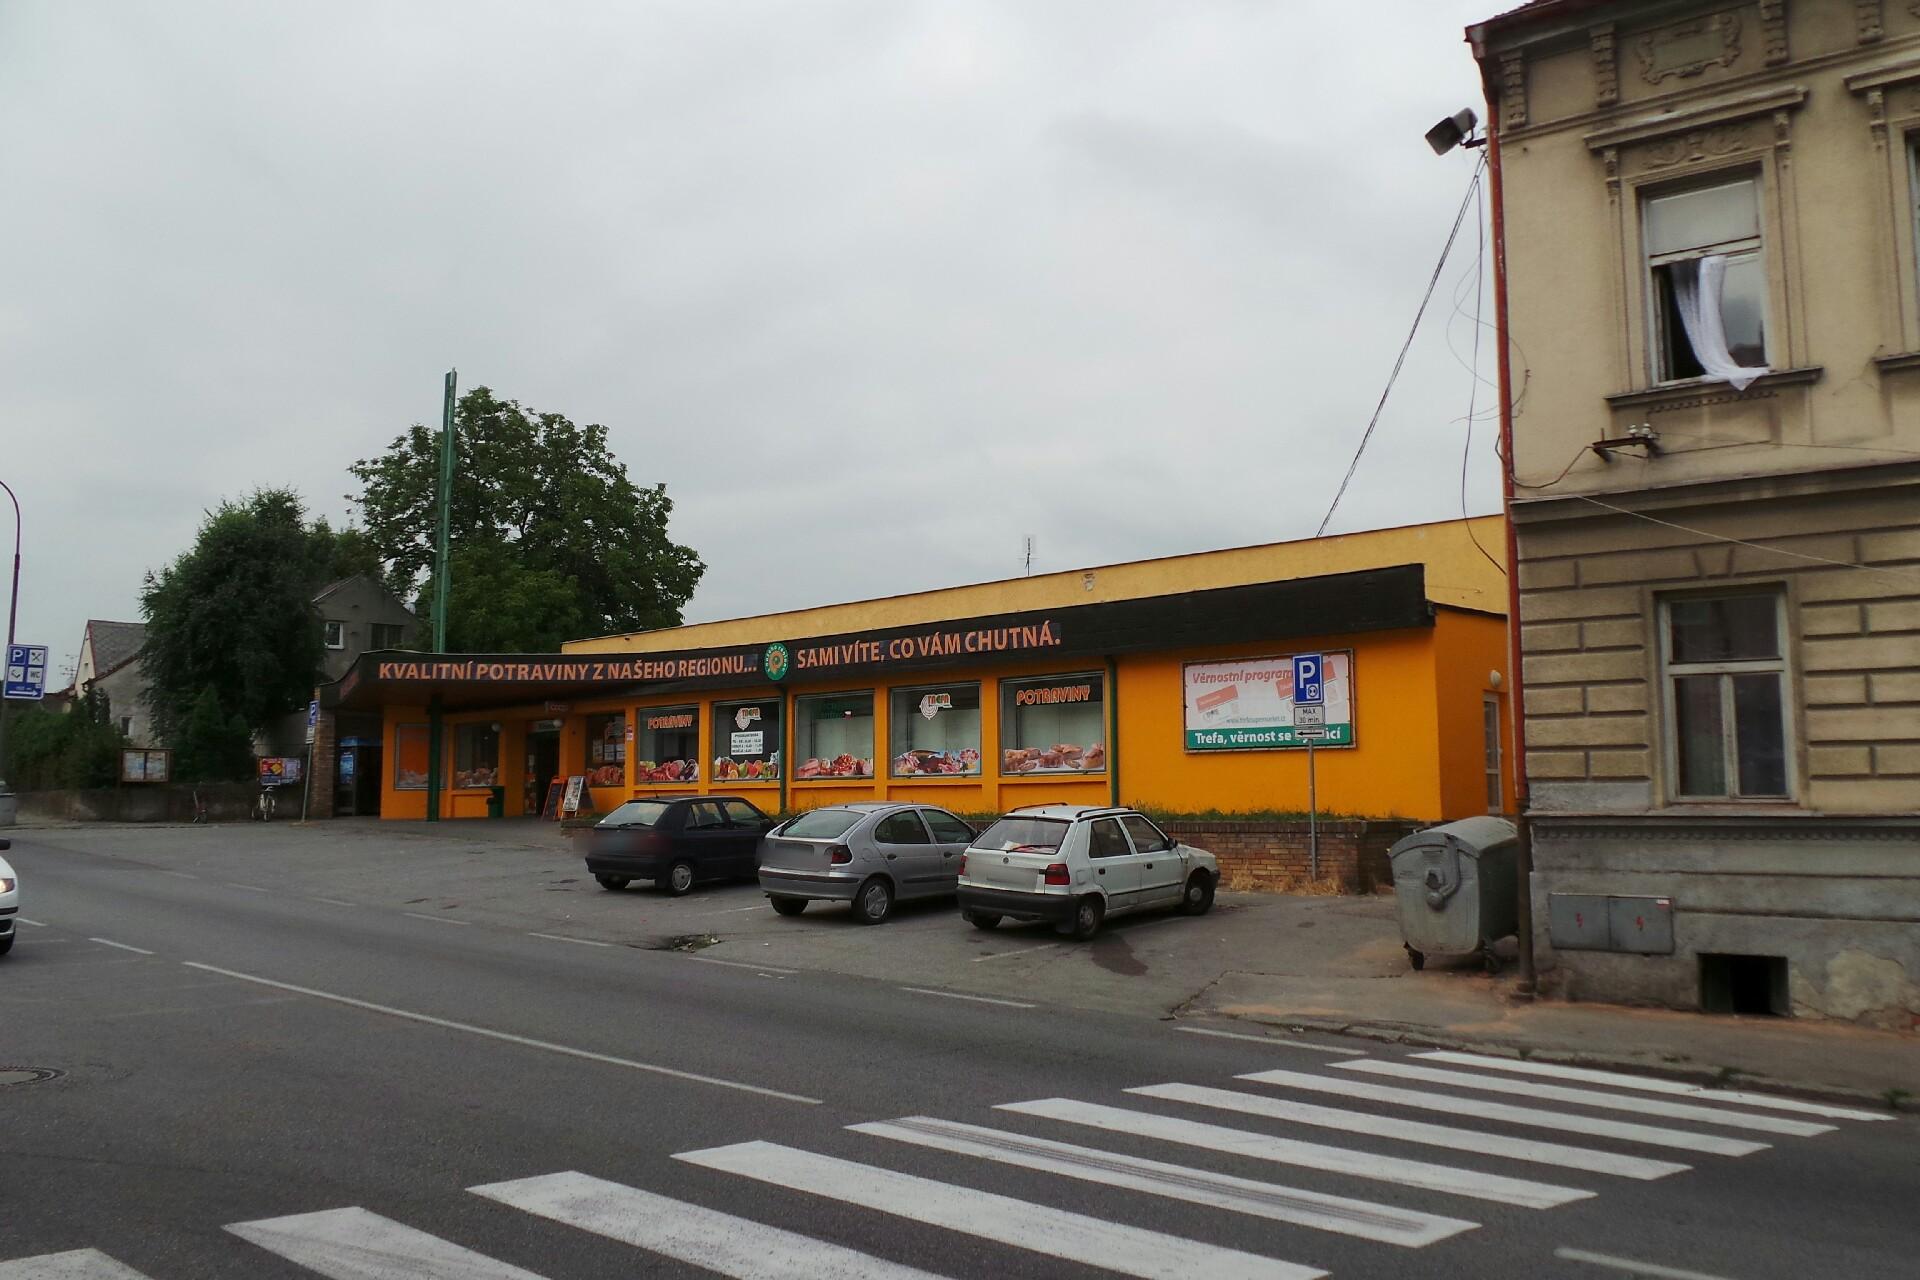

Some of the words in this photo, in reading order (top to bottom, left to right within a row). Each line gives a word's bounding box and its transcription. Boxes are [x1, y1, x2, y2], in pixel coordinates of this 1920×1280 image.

[797, 645, 839, 668] SAMI
[842, 640, 885, 664] VÍTE,
[889, 638, 915, 659] CO
[917, 631, 960, 656] VÁM
[965, 620, 1061, 652] CHUTNÁ.
[12, 649, 24, 662] P
[30, 671, 41, 679] WC
[379, 660, 474, 680] KVALITNÍ
[476, 663, 588, 681] POTRAVINY
[592, 663, 604, 680] Z
[607, 660, 676, 680] NAŠEHO
[678, 655, 758, 677] REGIONU...
[1299, 661, 1316, 689] P
[1192, 669, 1244, 684] Věrnostní
[1016, 685, 1090, 706] POTRAVINY
[648, 714, 693, 730] POTRAVINY
[1308, 716, 1320, 724] min
[1194, 731, 1228, 745] Trefa,
[1230, 731, 1276, 743] věrnost
[1278, 732, 1292, 742] se
